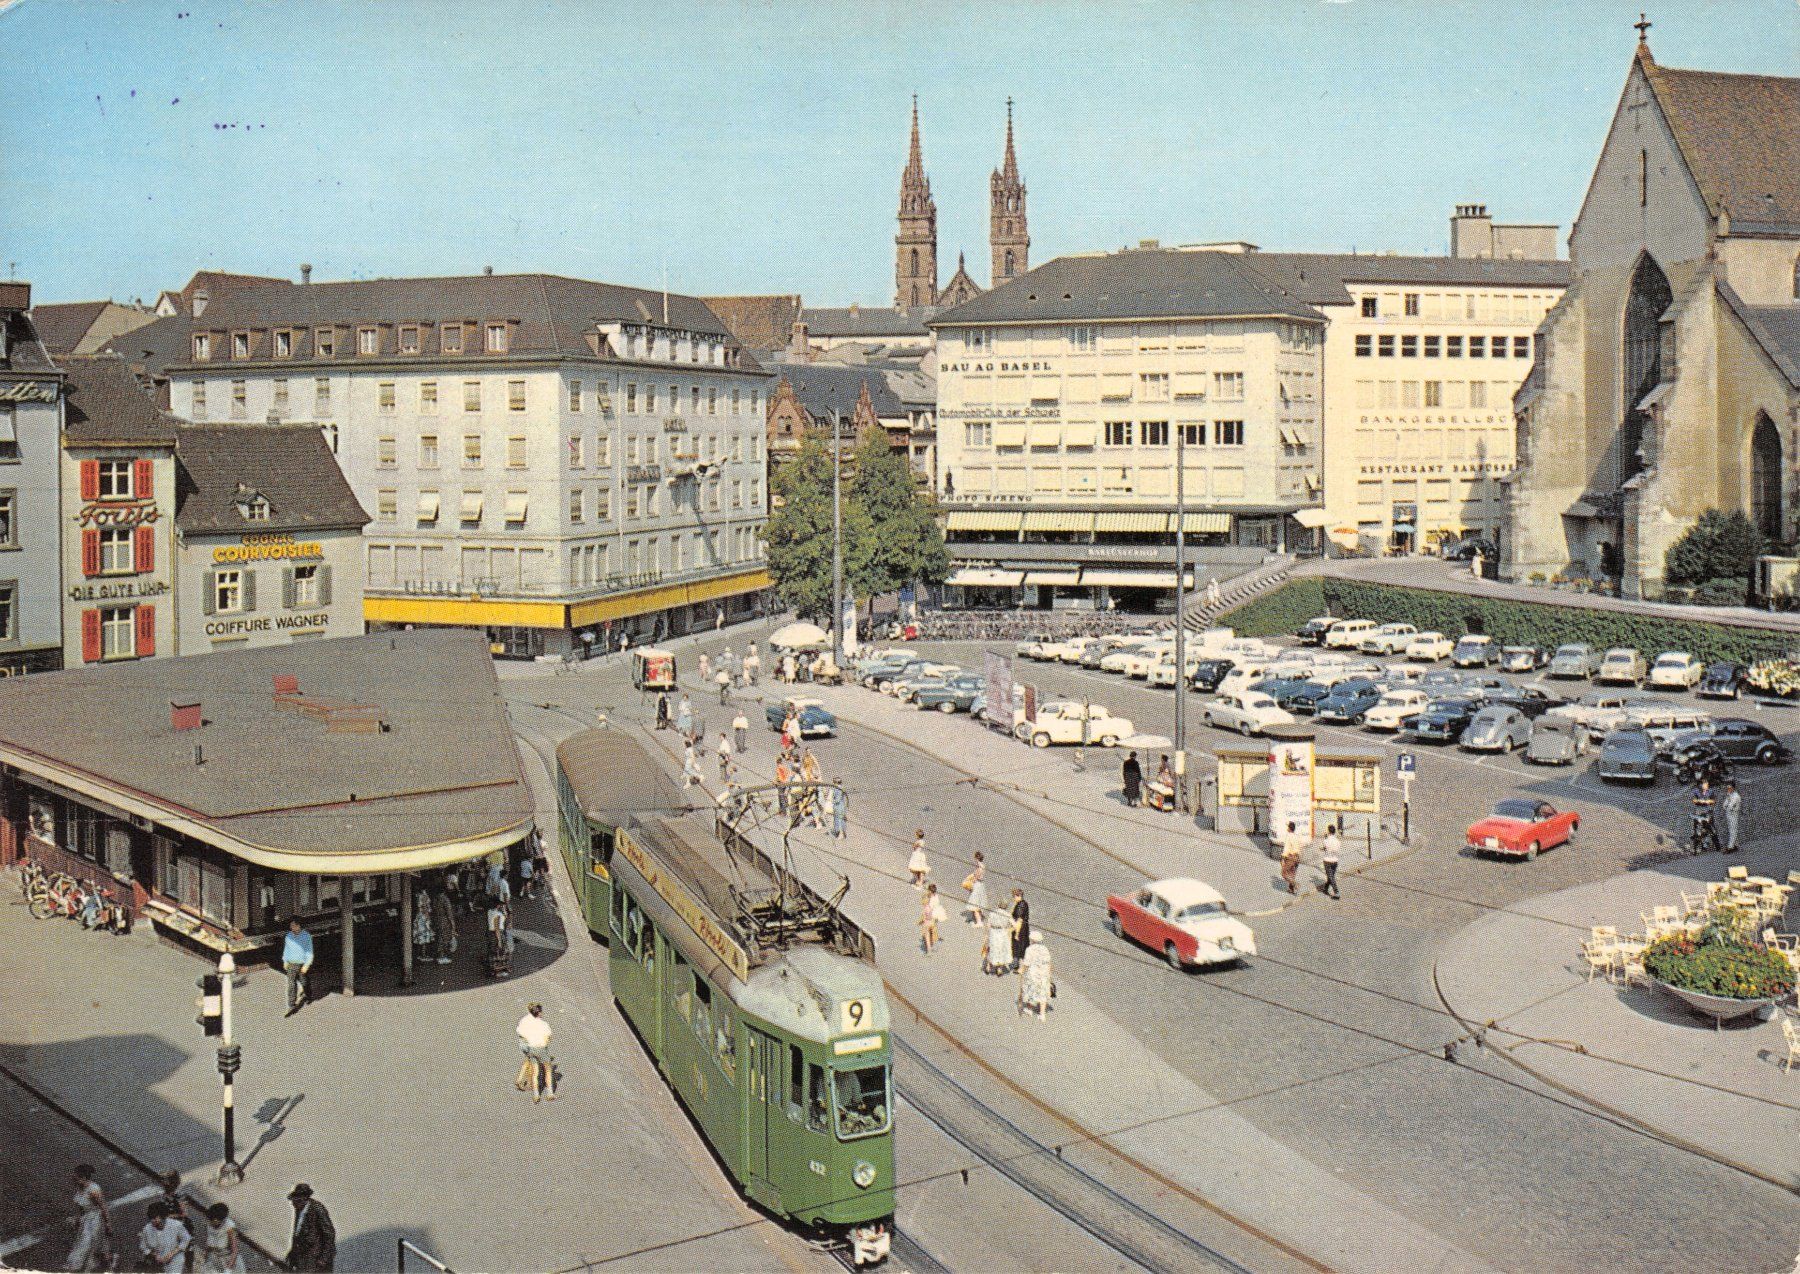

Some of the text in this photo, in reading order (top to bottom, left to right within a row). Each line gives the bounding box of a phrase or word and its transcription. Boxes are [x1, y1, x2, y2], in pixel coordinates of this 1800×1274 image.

[940, 363, 970, 372] BAU
[1001, 362, 1052, 371] BASEL
[1360, 465, 1445, 474] RESTAURANT
[241, 533, 295, 545] COGNAC
[212, 541, 323, 563] COURVOISIER
[73, 581, 165, 601] DIE GUTE UHR
[205, 613, 329, 636] COIFFURE WAGNER
[1400, 755, 1412, 770] P
[849, 1001, 864, 1028] 9
